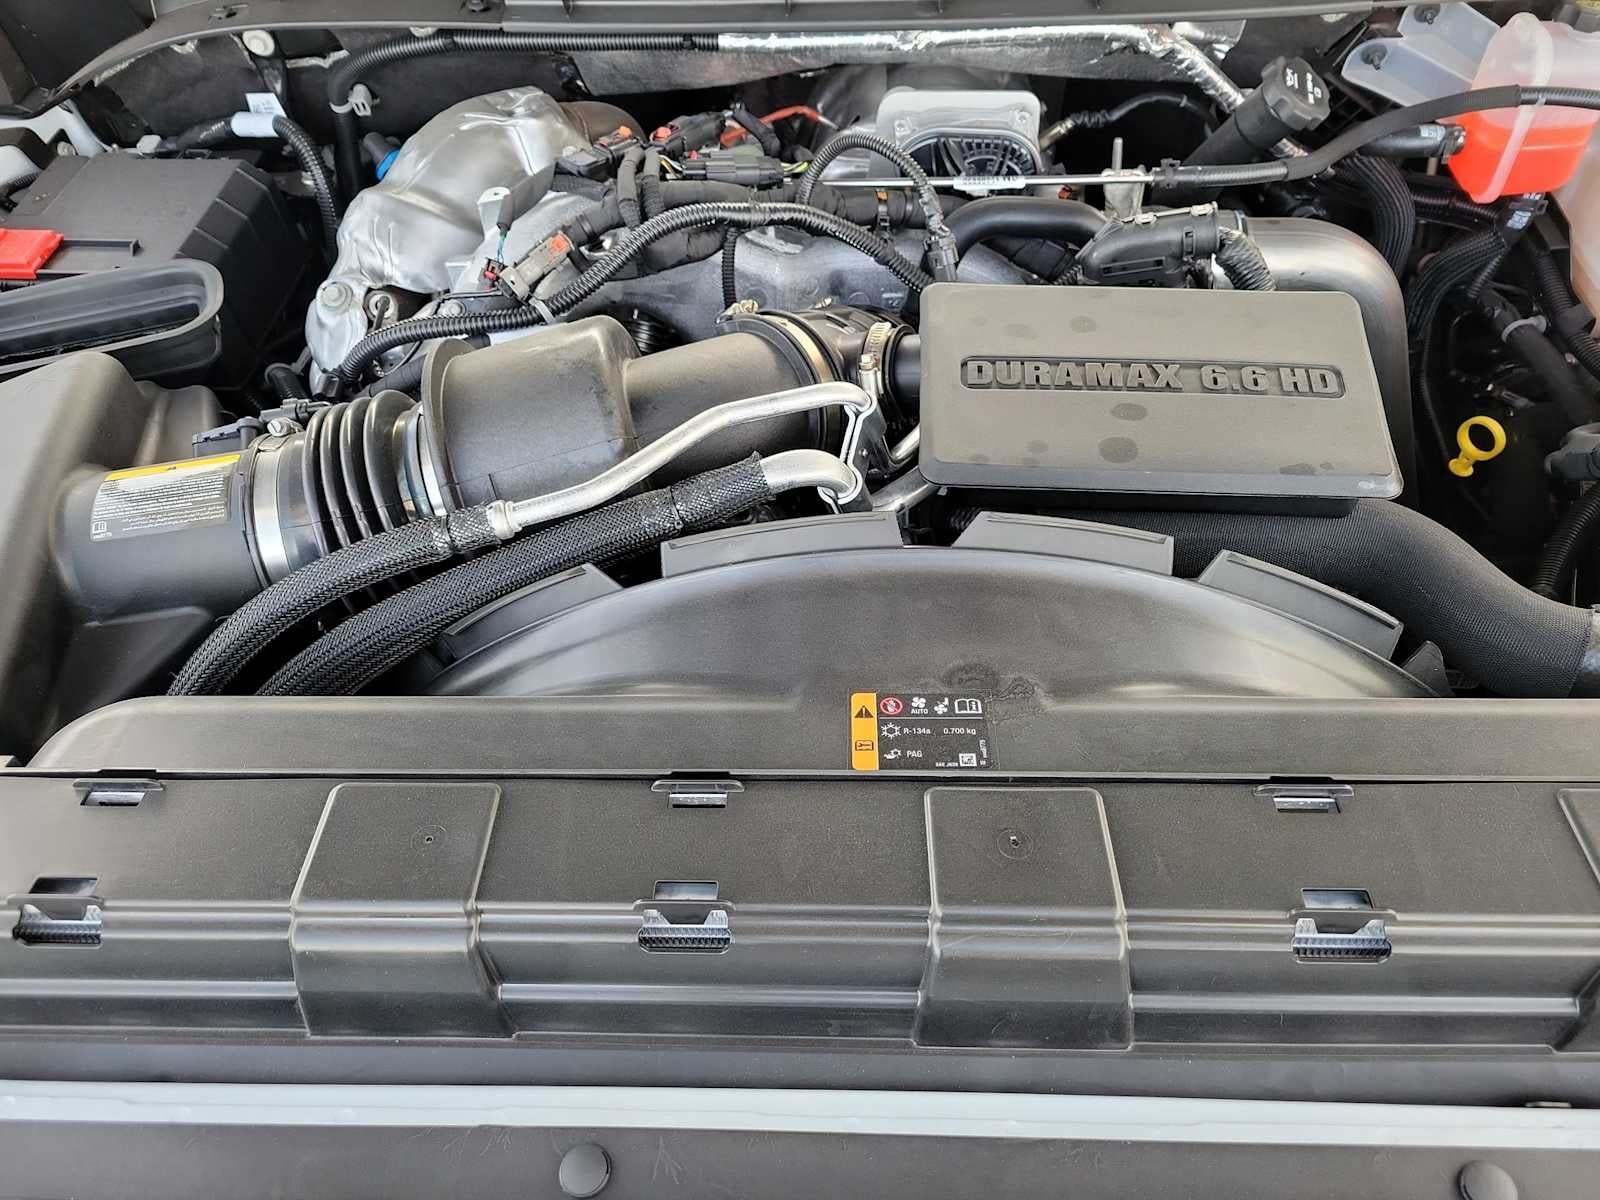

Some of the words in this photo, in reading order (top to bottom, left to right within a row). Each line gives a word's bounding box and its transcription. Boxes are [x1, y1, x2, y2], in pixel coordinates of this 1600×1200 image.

[967, 359, 1184, 391] DURAMAX
[1200, 365, 1267, 392] 6.6
[1279, 367, 1340, 395] HD
[906, 750, 923, 758] PAG
